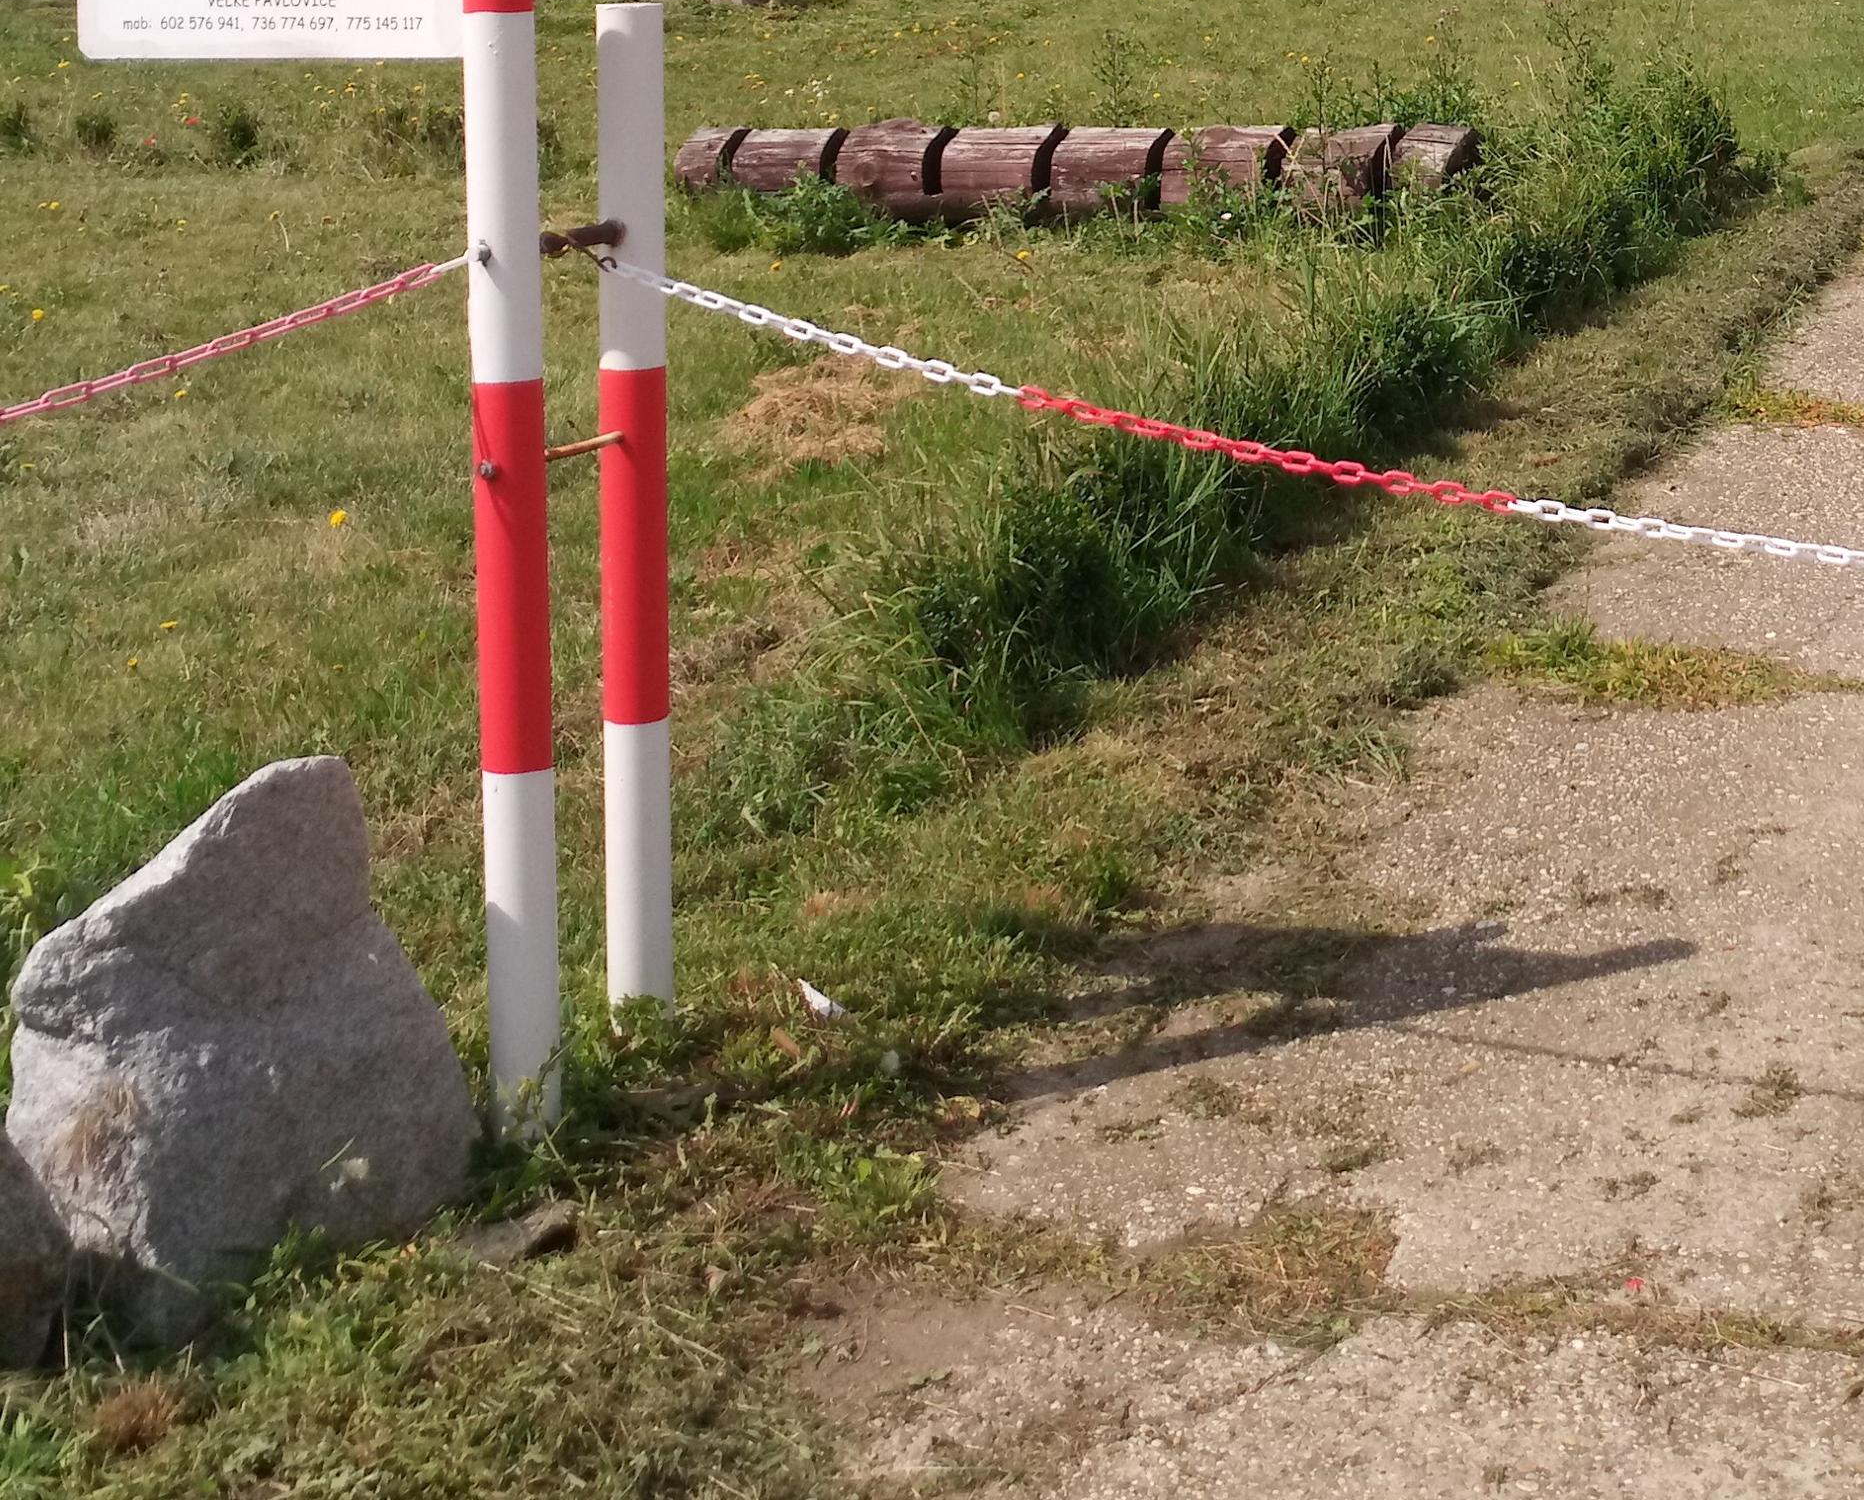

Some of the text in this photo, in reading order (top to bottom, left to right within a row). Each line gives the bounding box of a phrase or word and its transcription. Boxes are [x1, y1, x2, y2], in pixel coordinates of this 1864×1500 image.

[122, 17, 423, 32] mob: 602 576 941, 736 774 697, 775 145 117
